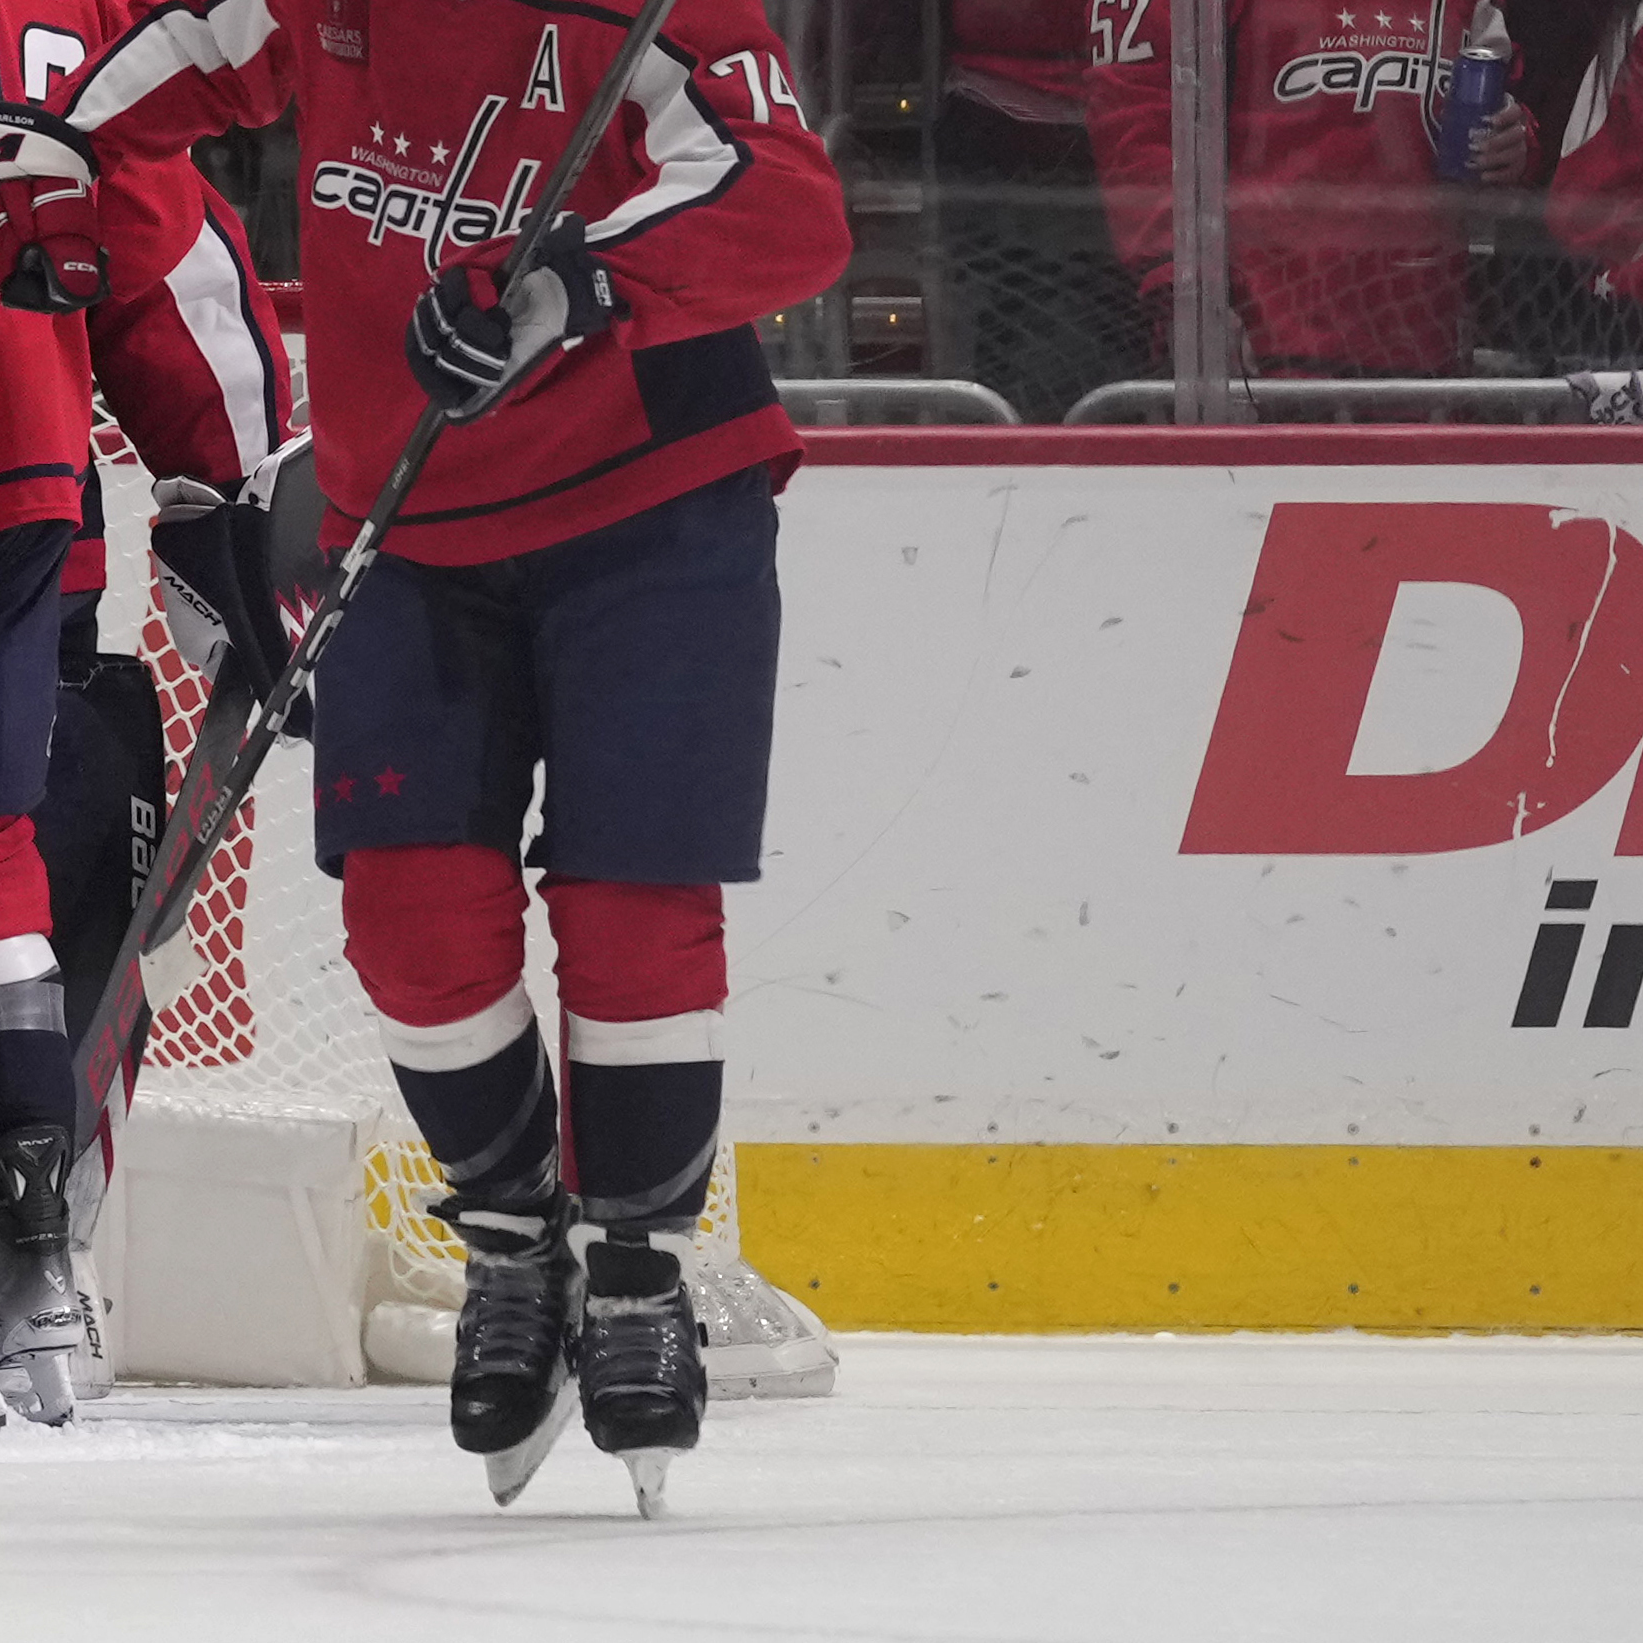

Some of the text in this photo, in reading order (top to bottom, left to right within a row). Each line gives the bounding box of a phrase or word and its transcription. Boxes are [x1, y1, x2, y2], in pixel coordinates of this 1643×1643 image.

[520, 23, 567, 114] A
[1318, 34, 1428, 52] WASHINGTON
[710, 48, 811, 133] 74
[313, 94, 551, 283] capital
[351, 144, 447, 189] WASHINGTON
[163, 575, 222, 626] MACH
[1178, 502, 1643, 856] D
[76, 1290, 104, 1360] MACH
